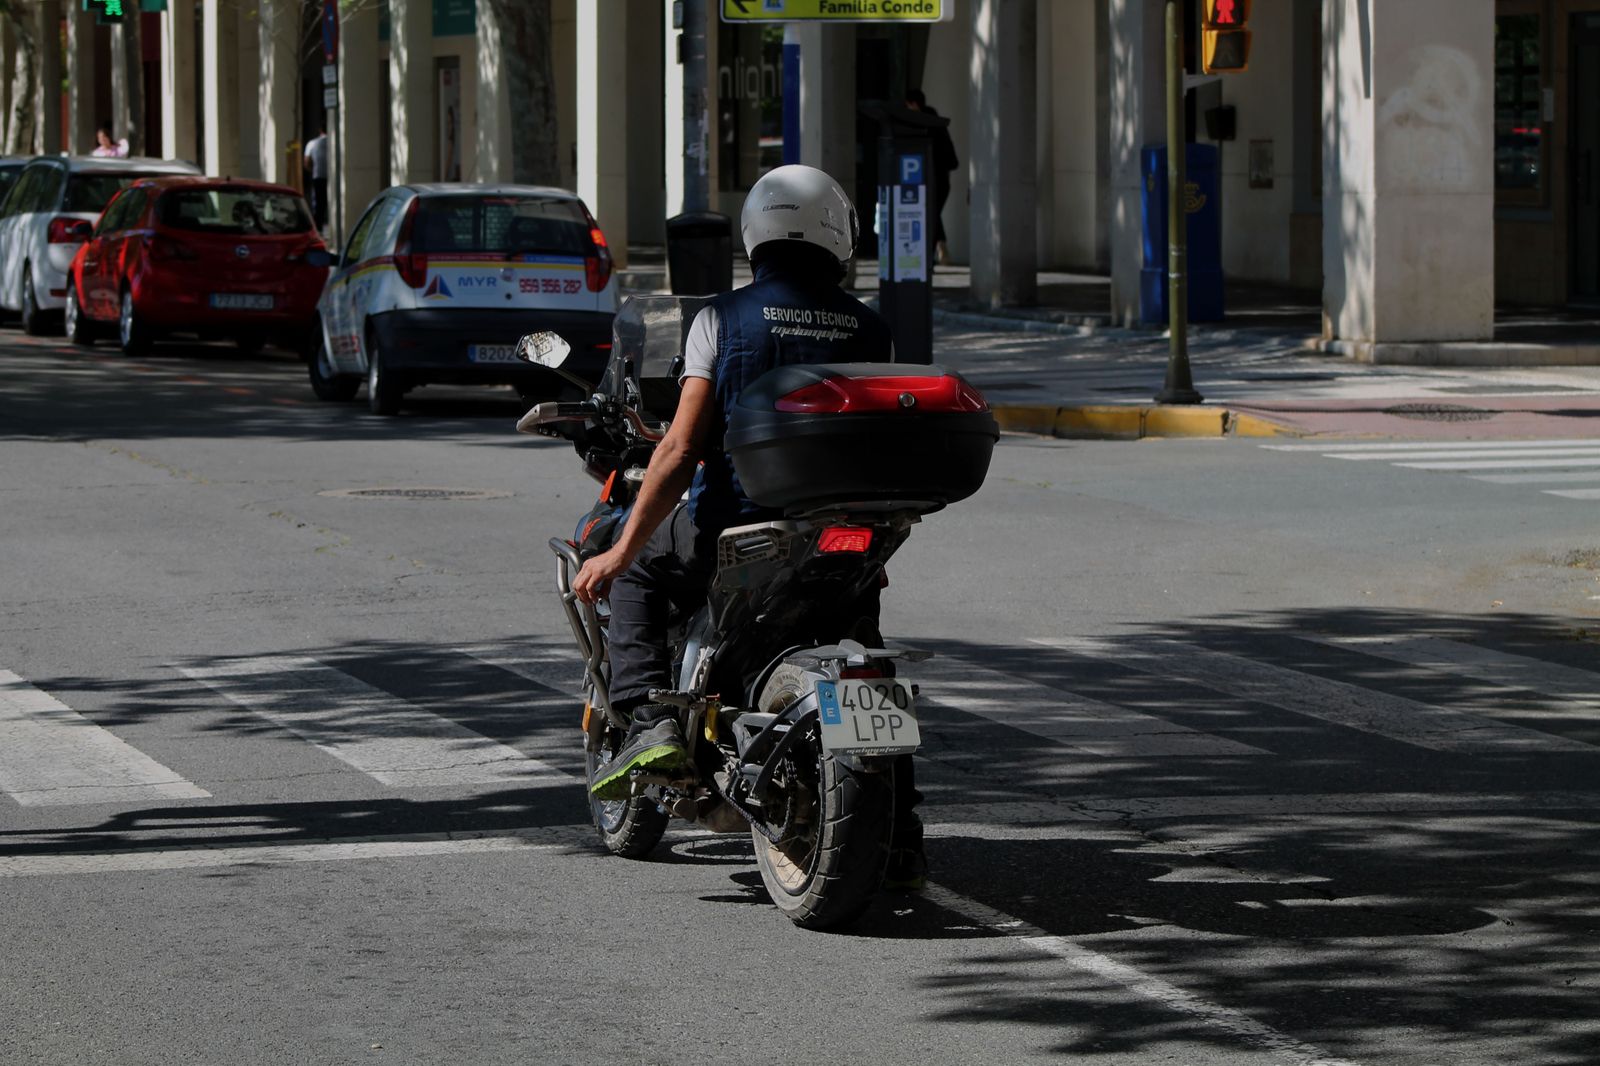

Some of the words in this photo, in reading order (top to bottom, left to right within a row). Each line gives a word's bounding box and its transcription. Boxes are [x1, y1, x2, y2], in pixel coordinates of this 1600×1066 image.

[819, 0, 876, 13] Familia
[881, 0, 933, 13] Conde
[903, 158, 919, 181] P
[458, 277, 497, 287] MYR
[519, 279, 540, 293] 959
[763, 307, 812, 324] SERVICIO
[814, 309, 858, 328] TÉCNICO
[479, 346, 515, 361] 8202
[842, 684, 908, 711] 4020
[826, 707, 836, 717] E
[853, 714, 903, 741] LPP
